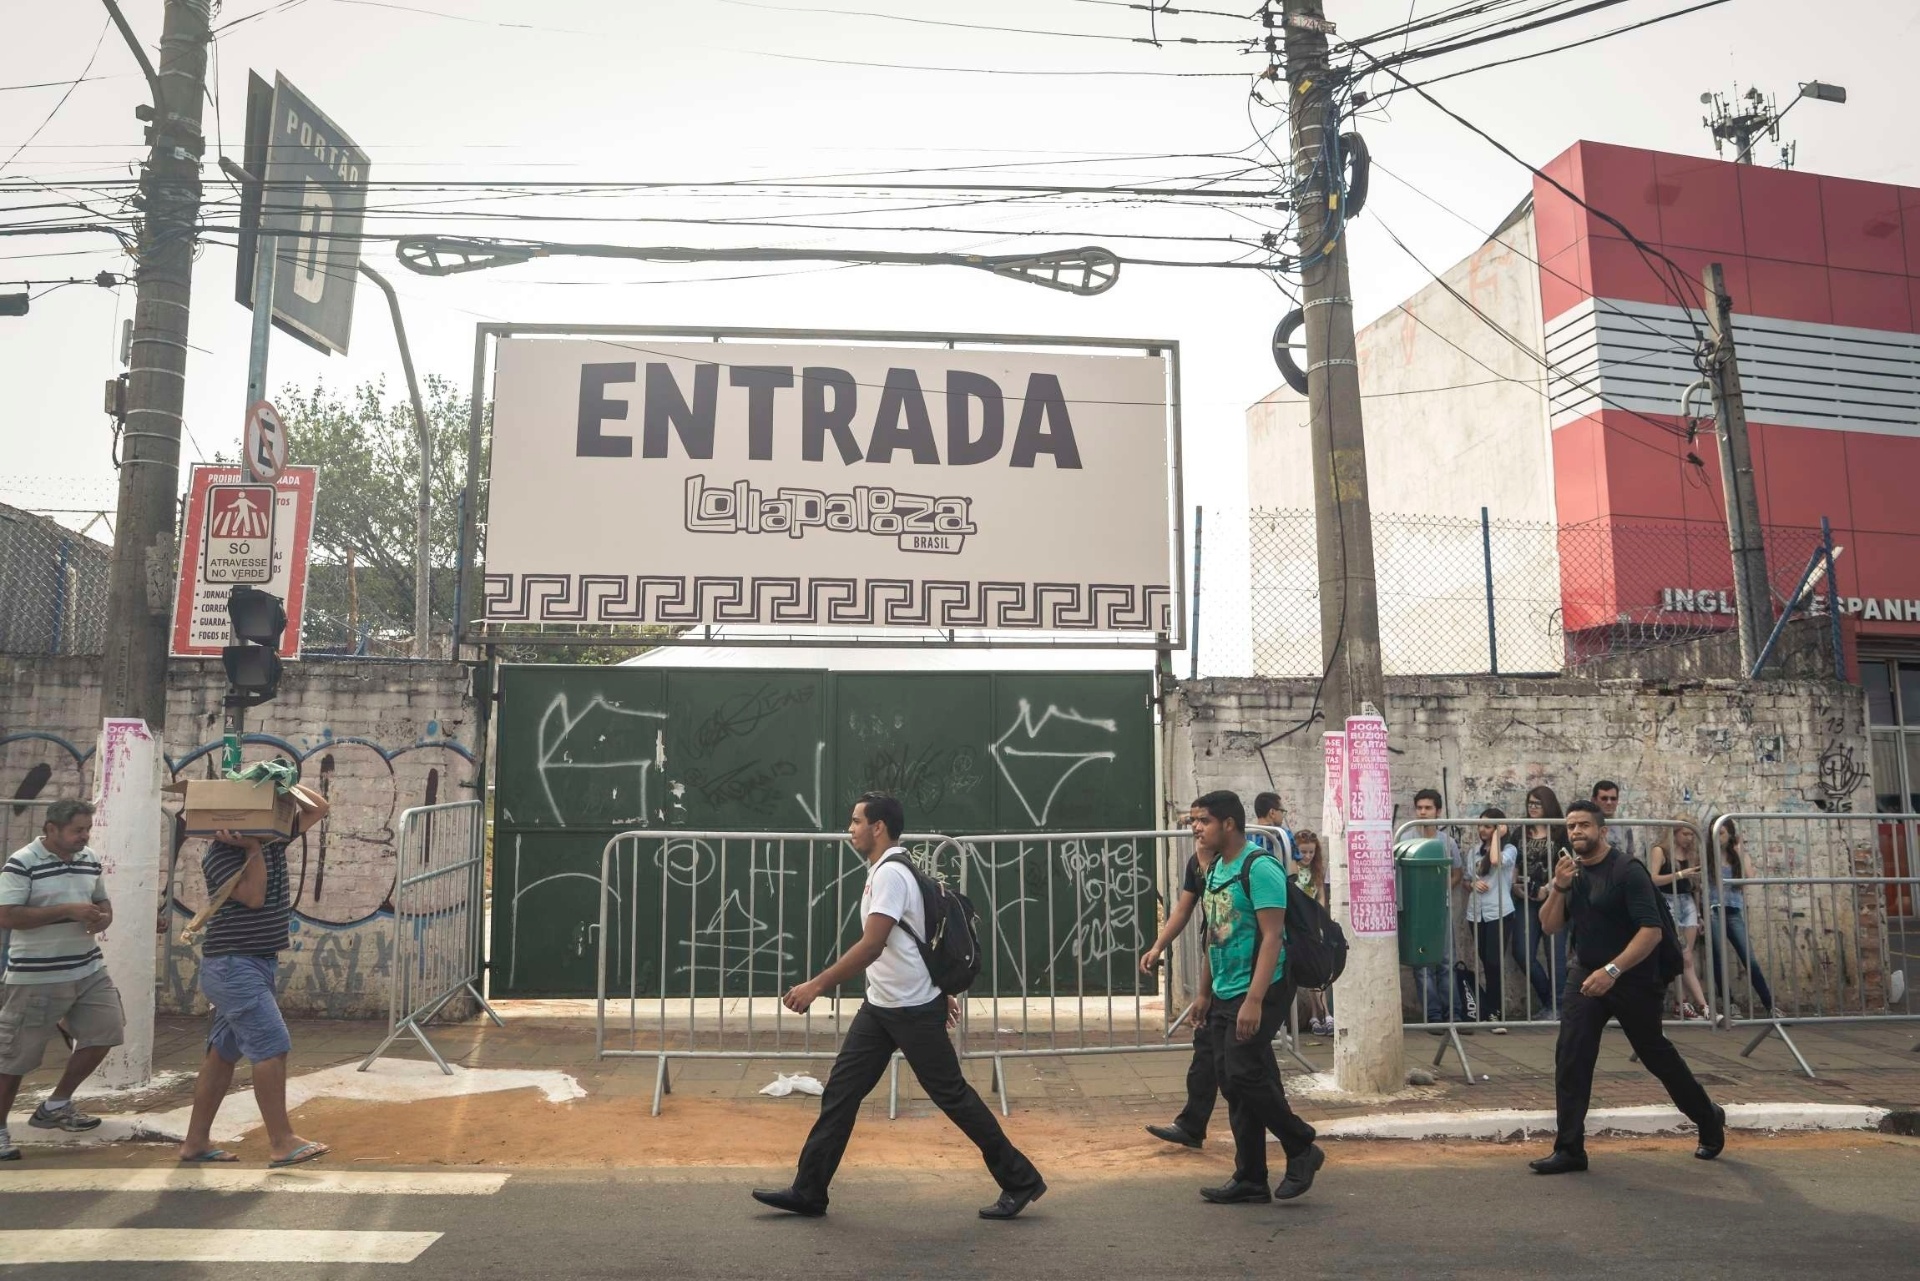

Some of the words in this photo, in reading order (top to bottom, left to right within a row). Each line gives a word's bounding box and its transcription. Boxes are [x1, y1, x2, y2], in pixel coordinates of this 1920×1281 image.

[287, 108, 359, 188] PORTÃO
[294, 175, 333, 304] D
[576, 361, 1083, 470] ENTRADA
[208, 473, 241, 484] PROIBID
[685, 474, 978, 540] Lollapalooza
[229, 539, 250, 555] SÓ
[913, 535, 950, 550] BRASIL
[210, 558, 268, 567] ATRAVESSE
[211, 569, 227, 578] NO
[231, 569, 265, 578] VERDE
[201, 603, 228, 613] CORREN
[1663, 587, 1737, 614] INGL
[198, 631, 220, 640] FOGOS
[220, 631, 230, 640] DE
